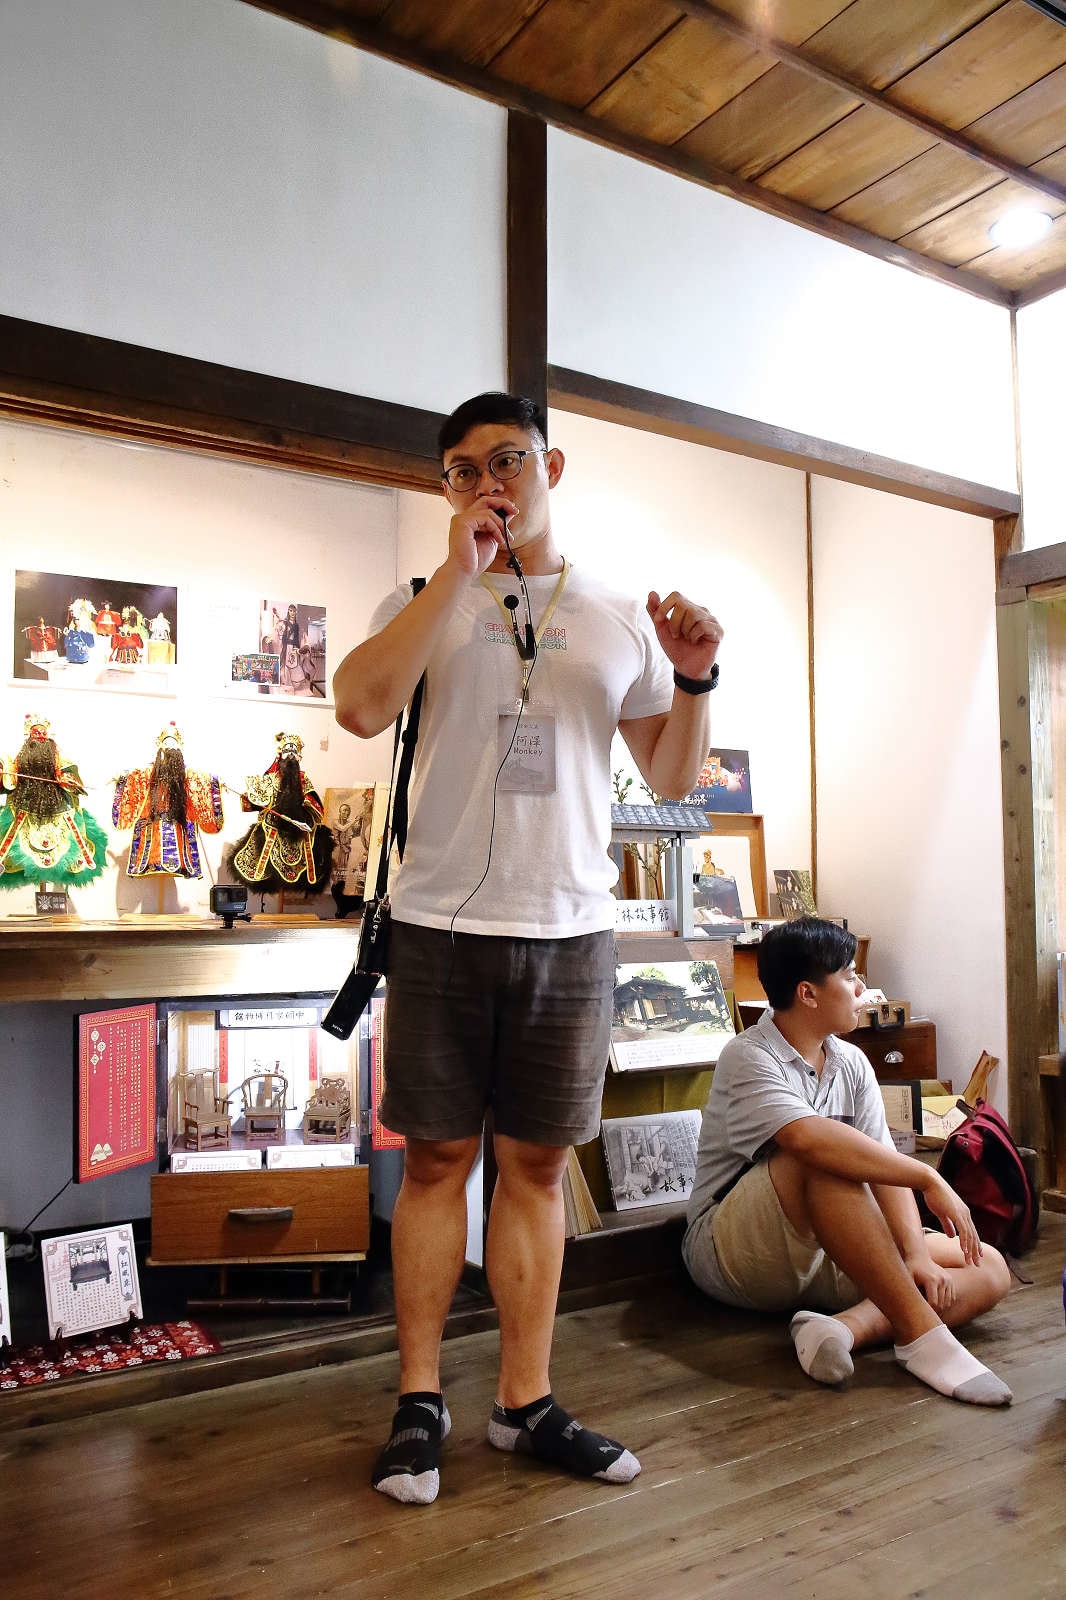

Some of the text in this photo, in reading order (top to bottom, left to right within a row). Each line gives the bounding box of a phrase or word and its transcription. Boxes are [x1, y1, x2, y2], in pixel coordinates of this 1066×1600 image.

[513, 747, 543, 757] Monkey
[615, 904, 670, 925] 林故事館
